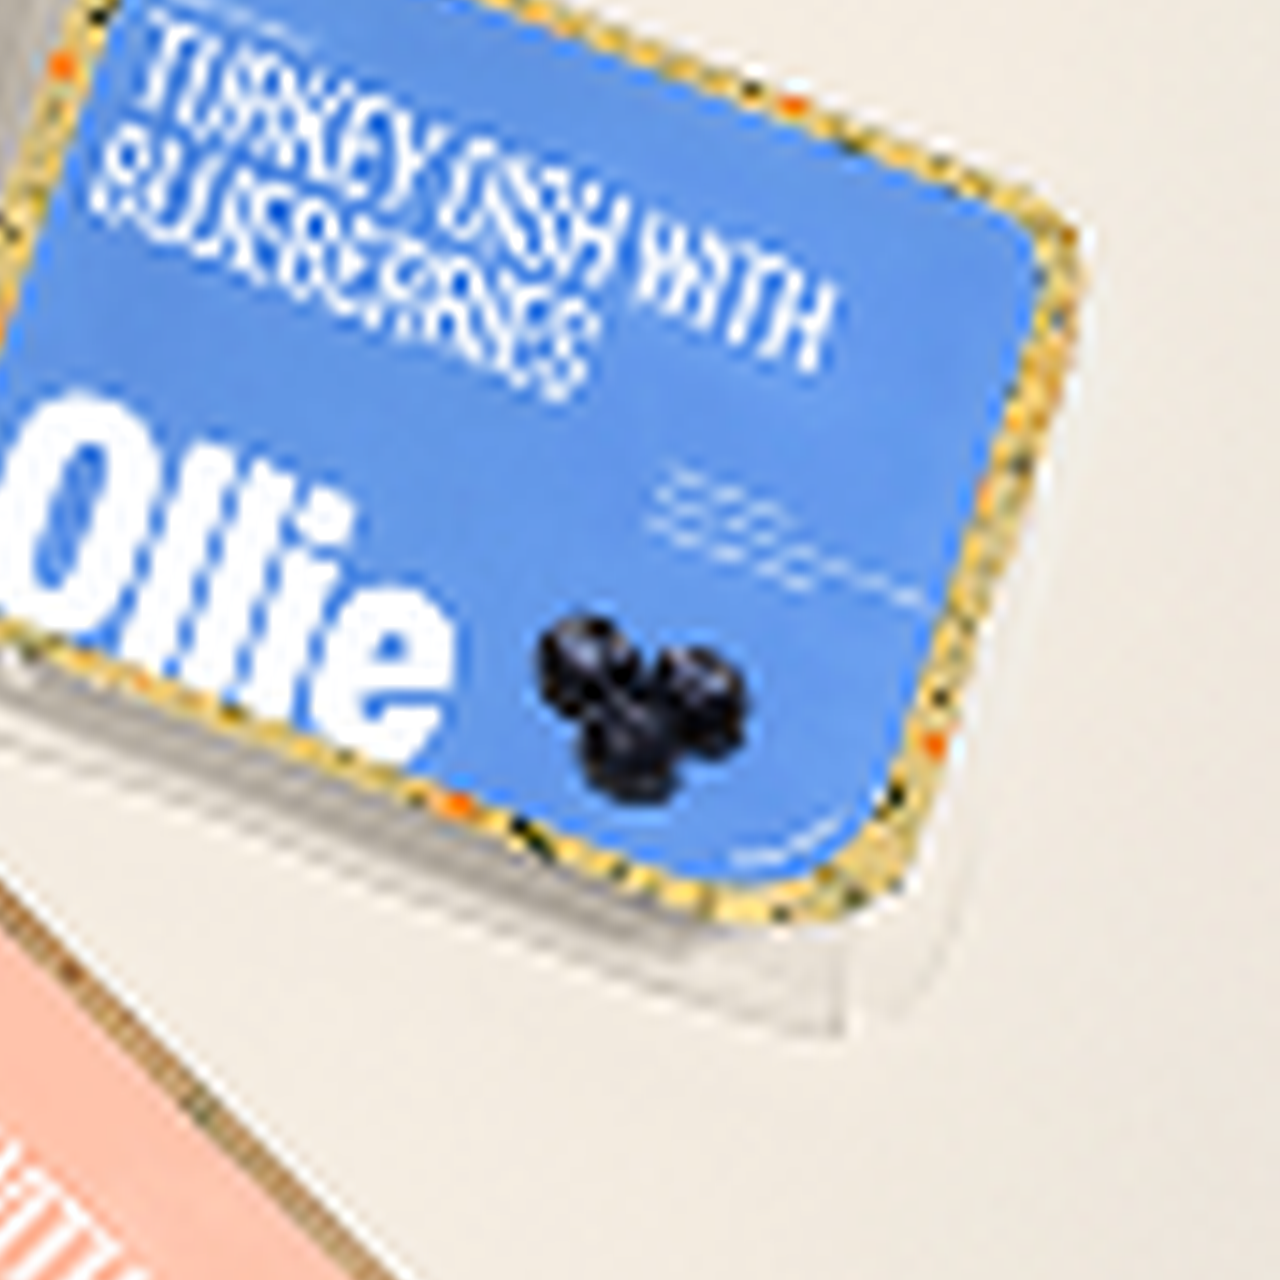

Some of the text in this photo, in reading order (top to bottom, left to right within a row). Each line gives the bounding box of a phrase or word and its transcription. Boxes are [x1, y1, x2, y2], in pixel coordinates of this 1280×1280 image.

[138, 11, 452, 211] TURKEY
[438, 136, 631, 288] DISH
[636, 212, 837, 373] WITH
